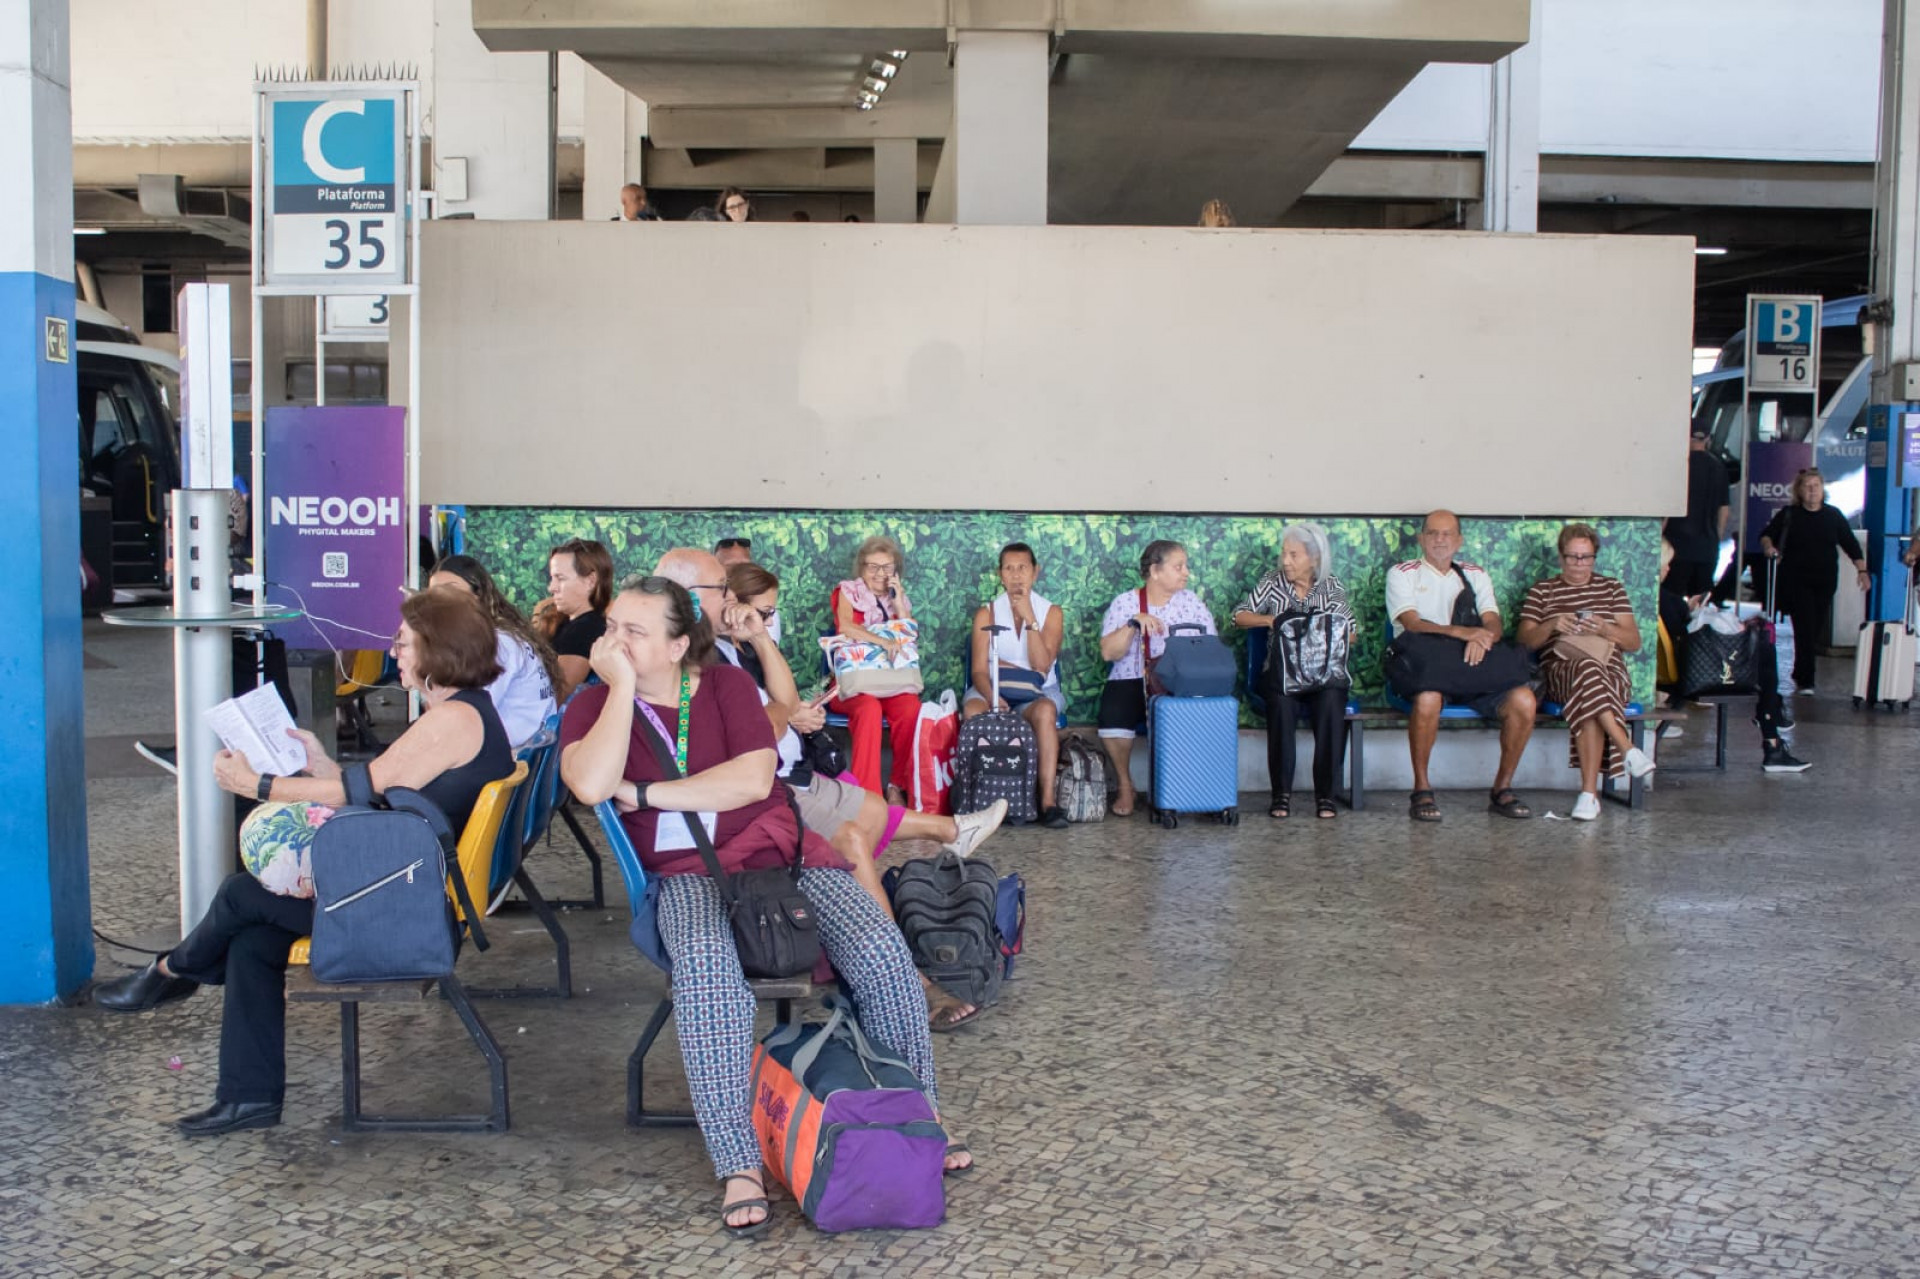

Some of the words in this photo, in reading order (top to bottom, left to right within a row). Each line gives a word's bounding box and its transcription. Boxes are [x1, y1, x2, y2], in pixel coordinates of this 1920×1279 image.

[303, 99, 366, 184] C
[317, 187, 386, 201] Plataforma
[350, 201, 386, 210] Platform
[324, 219, 385, 270] 35
[1773, 303, 1800, 342] B
[1780, 357, 1806, 380] 16
[1825, 445, 1866, 457] SALUT
[270, 496, 400, 526] NEOOH
[298, 527, 340, 536] PHYGITAL
[340, 528, 376, 536] MAKERS
